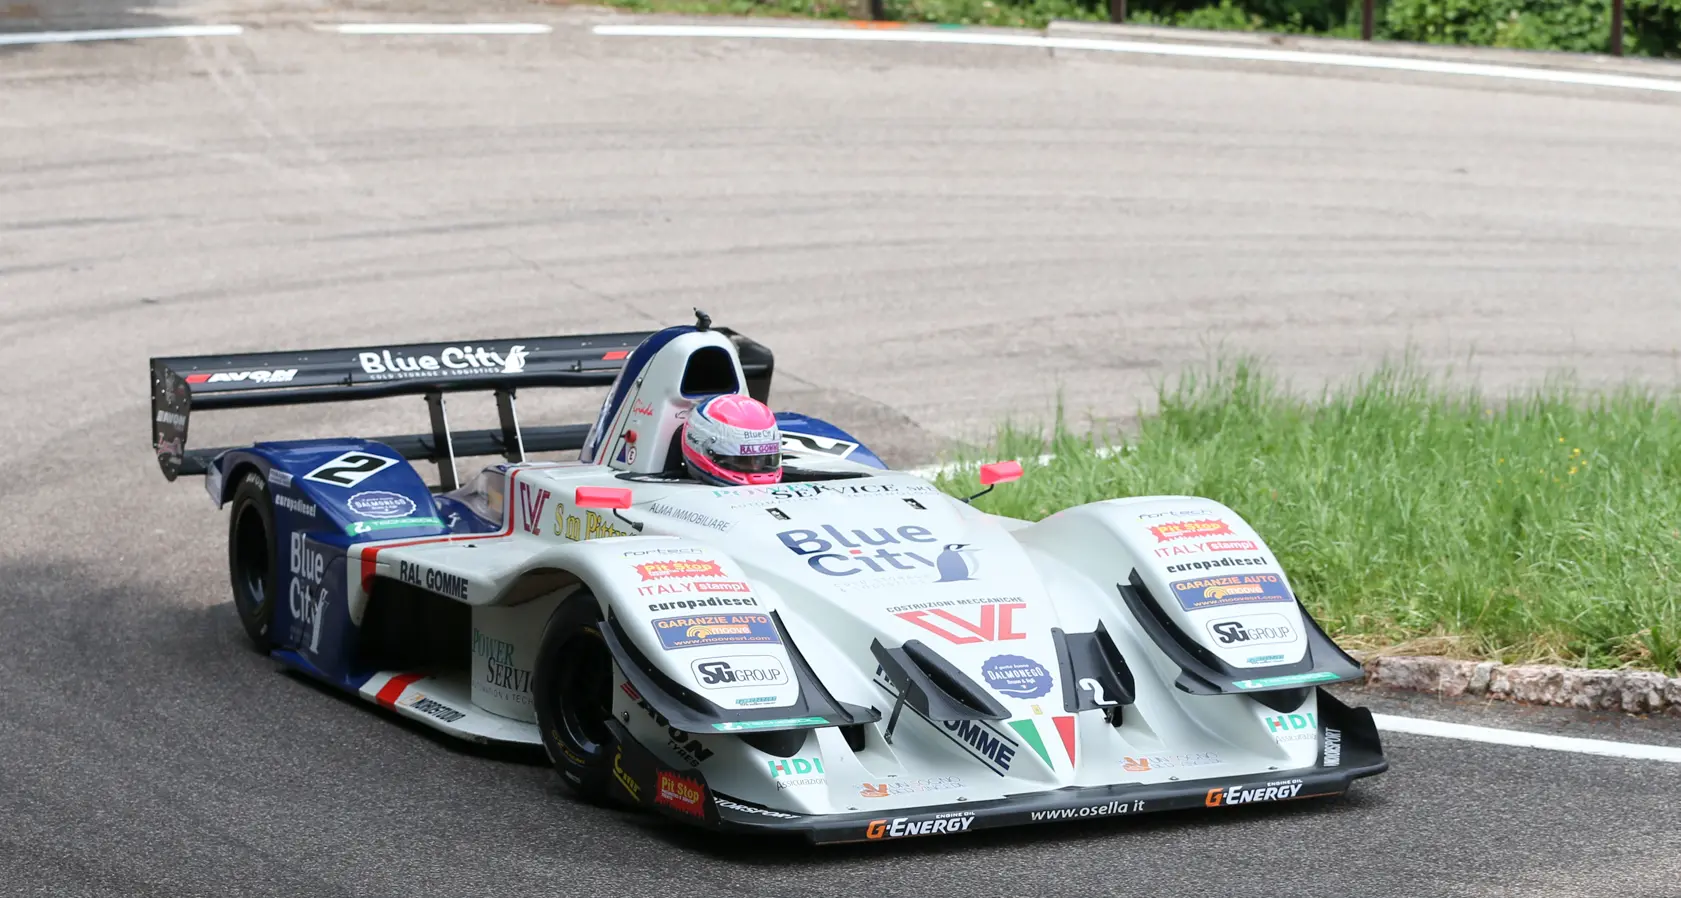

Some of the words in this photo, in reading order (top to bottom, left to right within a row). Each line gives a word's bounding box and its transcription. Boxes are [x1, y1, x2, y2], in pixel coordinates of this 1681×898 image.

[359, 350, 440, 374] Blue
[207, 368, 298, 383] AVON
[744, 430, 761, 439] Blue
[740, 445, 757, 454] RAL
[312, 454, 387, 485] 2
[650, 502, 674, 518] ALMA
[672, 505, 730, 531] IMMOBILIARE
[1184, 522, 1222, 531] Stop
[777, 524, 937, 556] Blue
[290, 531, 323, 584] Blue
[1154, 542, 1206, 558] ITALY
[644, 563, 670, 571] Pit
[674, 561, 713, 571] Stop
[1166, 557, 1268, 573] europadiesel
[400, 560, 422, 585] RAL
[426, 568, 469, 600] GOMME
[1175, 576, 1241, 590] GARANZIE
[1244, 575, 1278, 583] AUTO
[637, 583, 693, 596] ITALY
[648, 596, 758, 612] europadiesel
[886, 600, 955, 613] COSTRUZIONI
[957, 596, 1024, 606] MECCANICHE
[658, 616, 728, 628] GARANZIE
[731, 616, 768, 624] AUTO
[893, 603, 1027, 645] CVC
[1248, 627, 1290, 641] GROUP
[472, 628, 515, 668] POWER
[734, 668, 781, 682] GROUP
[987, 667, 1044, 681] DALMONEGO
[1079, 678, 1117, 705] 2
[1265, 713, 1316, 732] HDI
[668, 740, 700, 768] TYRES
[768, 757, 825, 778] HDI
[661, 776, 674, 793] Pit
[677, 782, 700, 803] Stop
